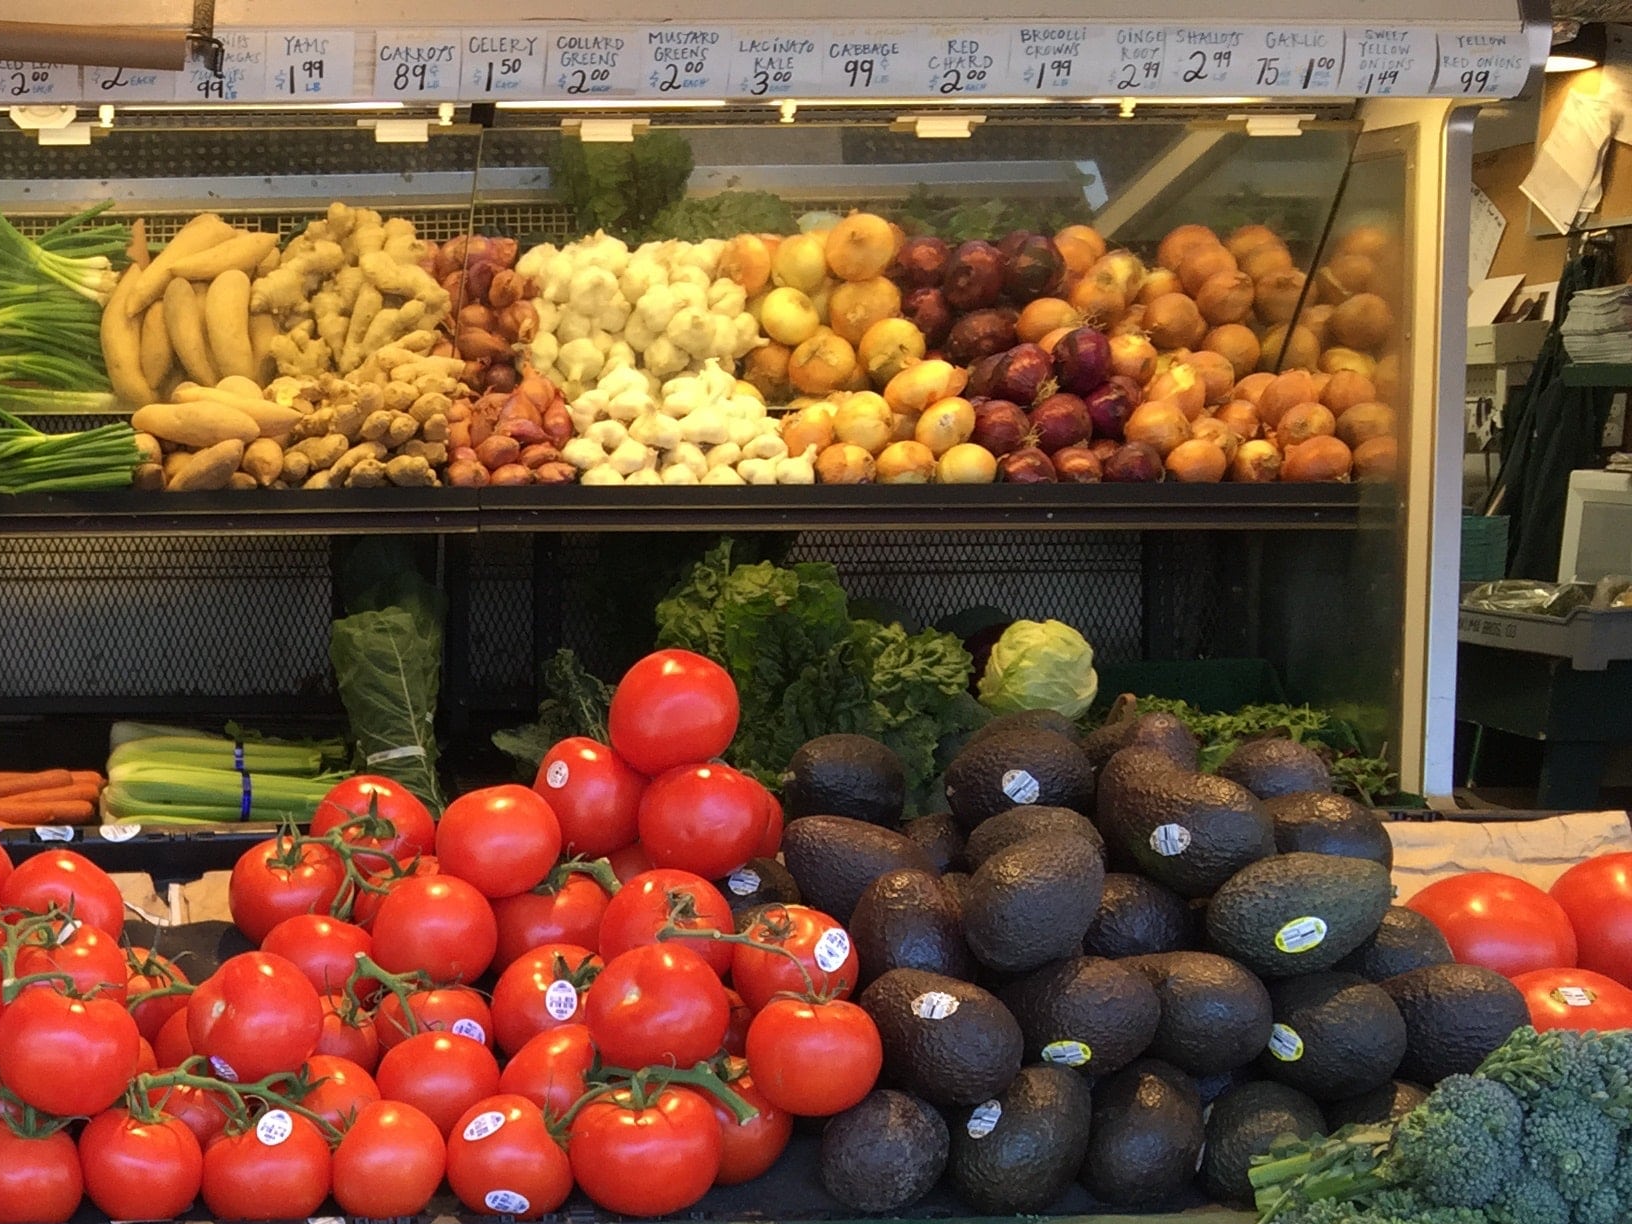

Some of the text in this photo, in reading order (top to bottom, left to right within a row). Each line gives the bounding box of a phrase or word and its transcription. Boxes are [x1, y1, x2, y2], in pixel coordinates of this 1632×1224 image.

[556, 35, 624, 51] COLLARD
[648, 30, 720, 46] MUSTARD
[1265, 32, 1329, 49] GARLIC
[1365, 28, 1409, 42] SWEET
[1456, 35, 1507, 49] YELLOW
[285, 36, 329, 56] YAMS
[468, 36, 538, 57] CELERY
[739, 36, 815, 54] LACINATO
[829, 43, 900, 59] CABBAGE
[947, 40, 979, 55] RED
[1025, 43, 1081, 58] CROWNS
[1358, 41, 1411, 58] YELLOW
[379, 45, 456, 62] CARROTS
[560, 51, 618, 68] GREENS
[654, 46, 710, 62] GREENS
[1121, 47, 1161, 62] ROOT
[754, 57, 795, 71] KALE
[928, 55, 994, 70] CHARD
[1359, 58, 1415, 72] ONIONS
[1443, 55, 1523, 70] RED ONIONS
